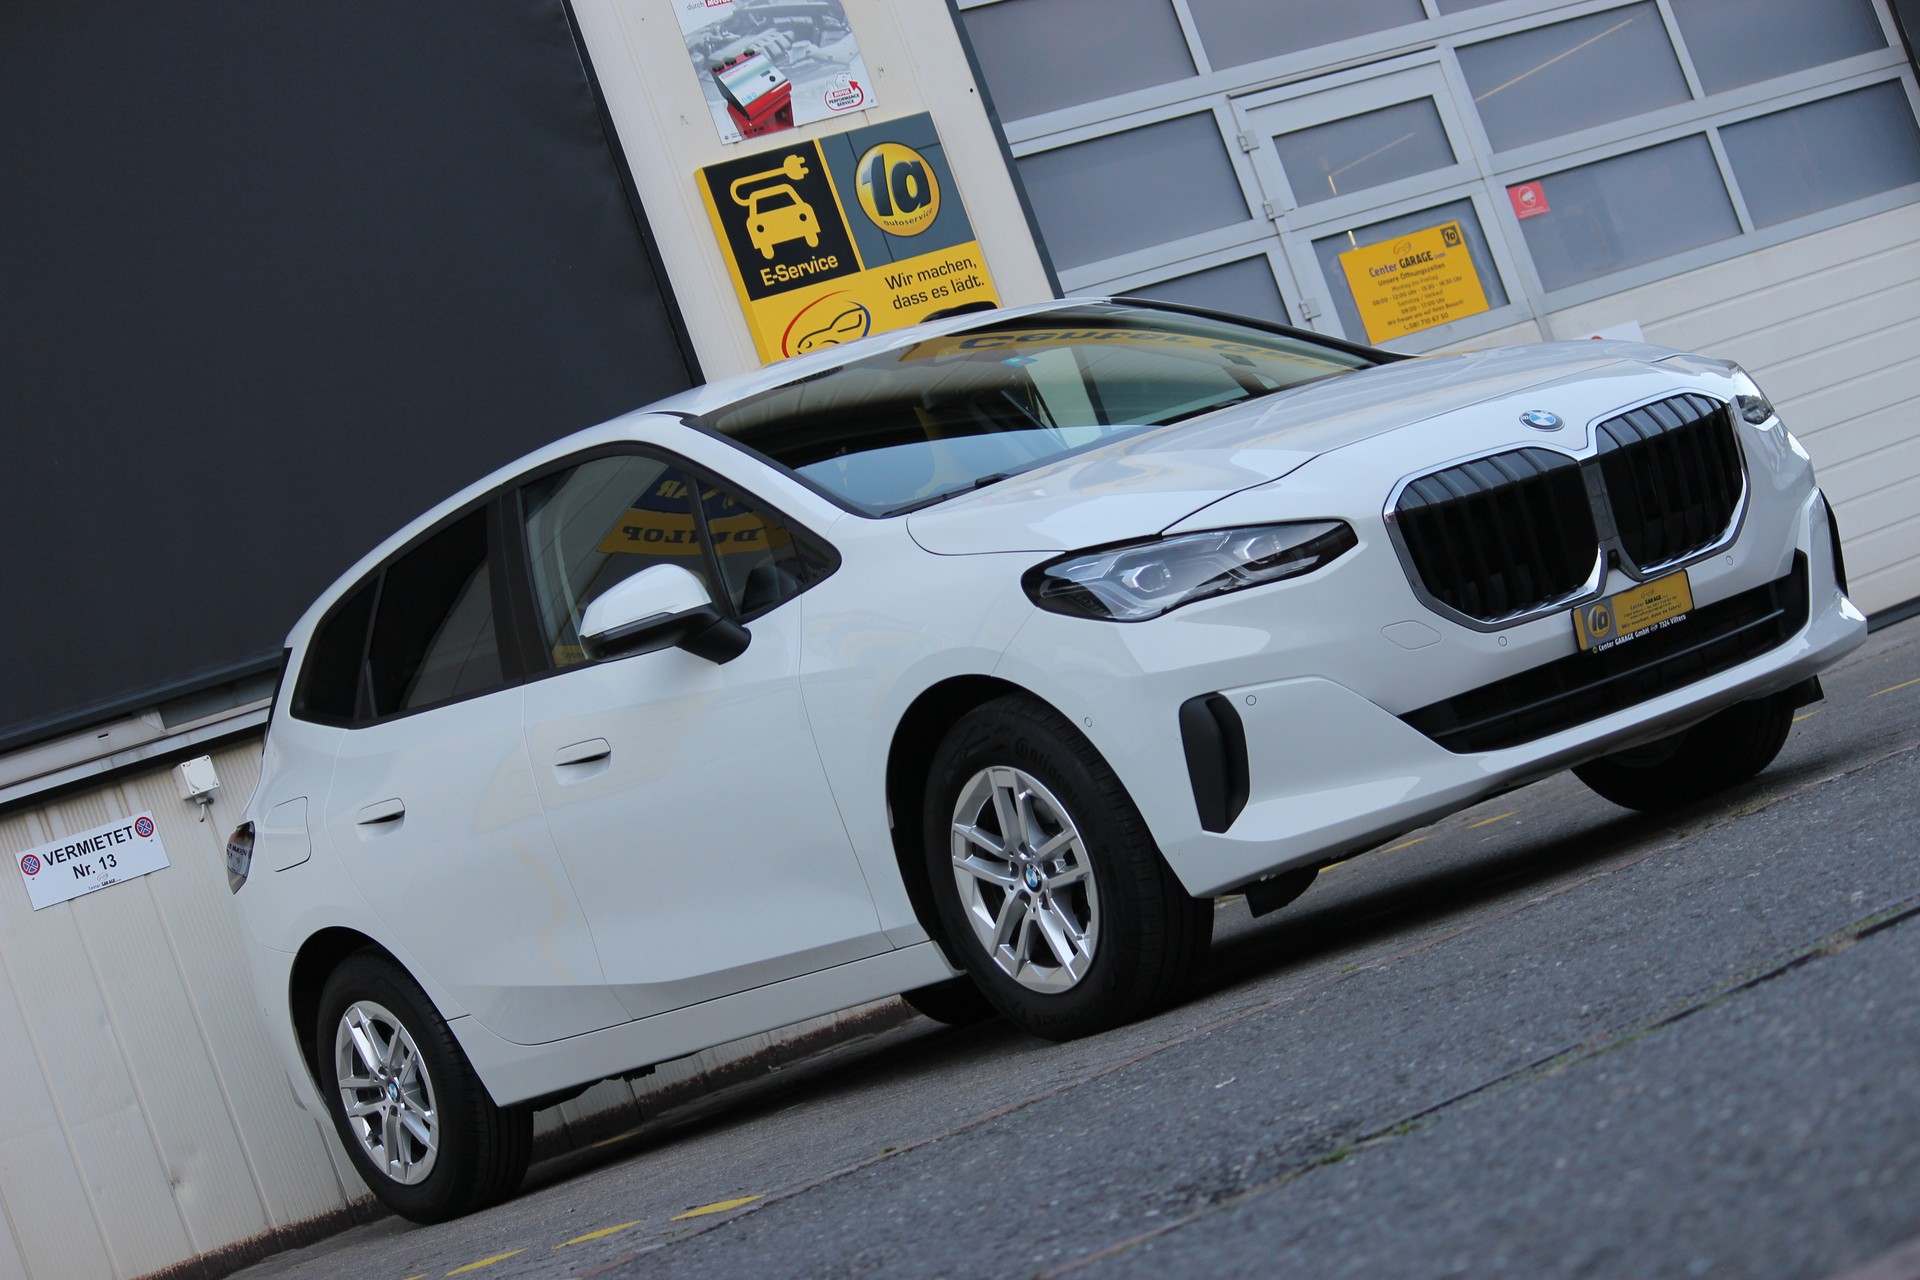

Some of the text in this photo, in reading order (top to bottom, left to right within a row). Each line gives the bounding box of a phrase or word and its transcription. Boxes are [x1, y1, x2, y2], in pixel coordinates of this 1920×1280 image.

[828, 93, 860, 105] PERFORMANCE
[837, 99, 855, 107] SERVICE
[883, 207, 933, 229] autoservice
[759, 254, 839, 287] E-Service
[885, 256, 978, 292] Wir machen,
[1369, 263, 1397, 278] Center
[1399, 250, 1434, 269] GARAGE
[1378, 262, 1446, 286] Unsere Öffnungszeiten
[892, 273, 985, 311] dass es lädt.
[1391, 282, 1412, 292] Montag
[1420, 275, 1439, 285] Freitag
[1645, 594, 1662, 605] GARAGE
[1598, 641, 1615, 652] Center
[1614, 633, 1634, 645] GARAGE
[1634, 626, 1650, 638] GmbH
[43, 825, 134, 867] VERMIETET
[72, 853, 118, 880] Nr. 13
